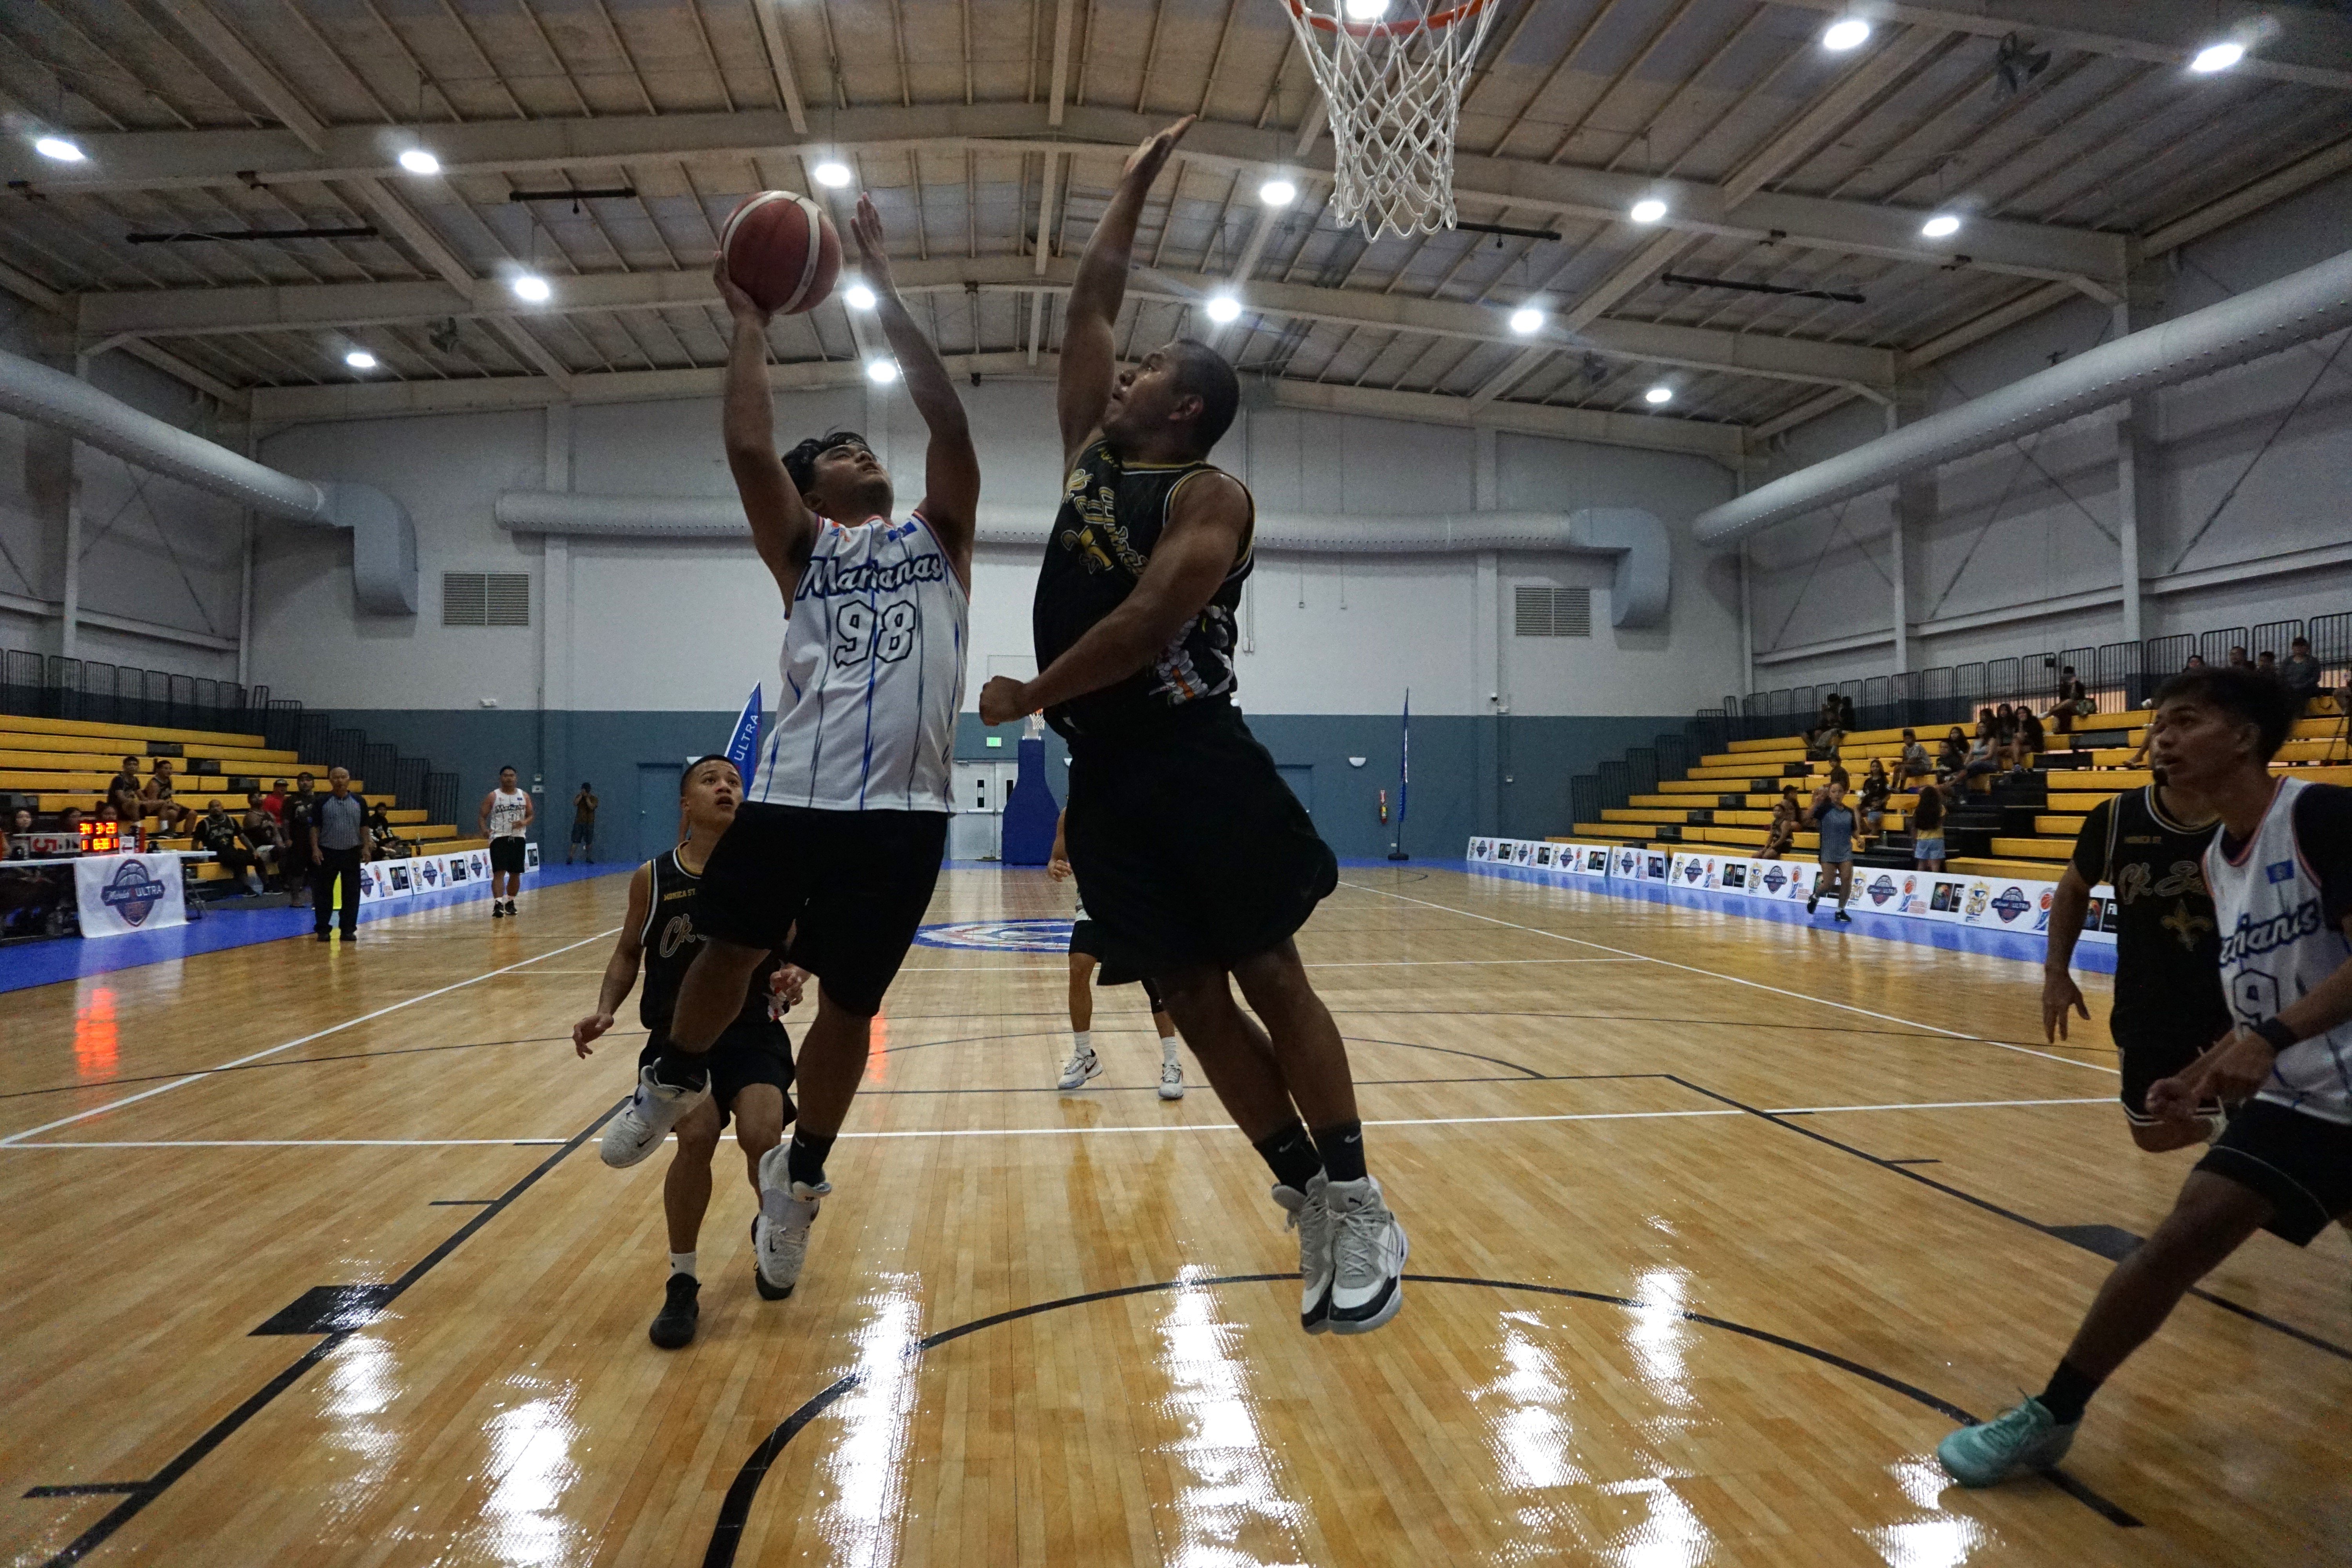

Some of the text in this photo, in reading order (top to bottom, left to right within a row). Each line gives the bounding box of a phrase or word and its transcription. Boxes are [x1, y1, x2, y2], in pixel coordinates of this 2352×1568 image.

[795, 554, 943, 601] Marianas
[833, 599, 916, 668] 98
[734, 715, 759, 761] ULTRA
